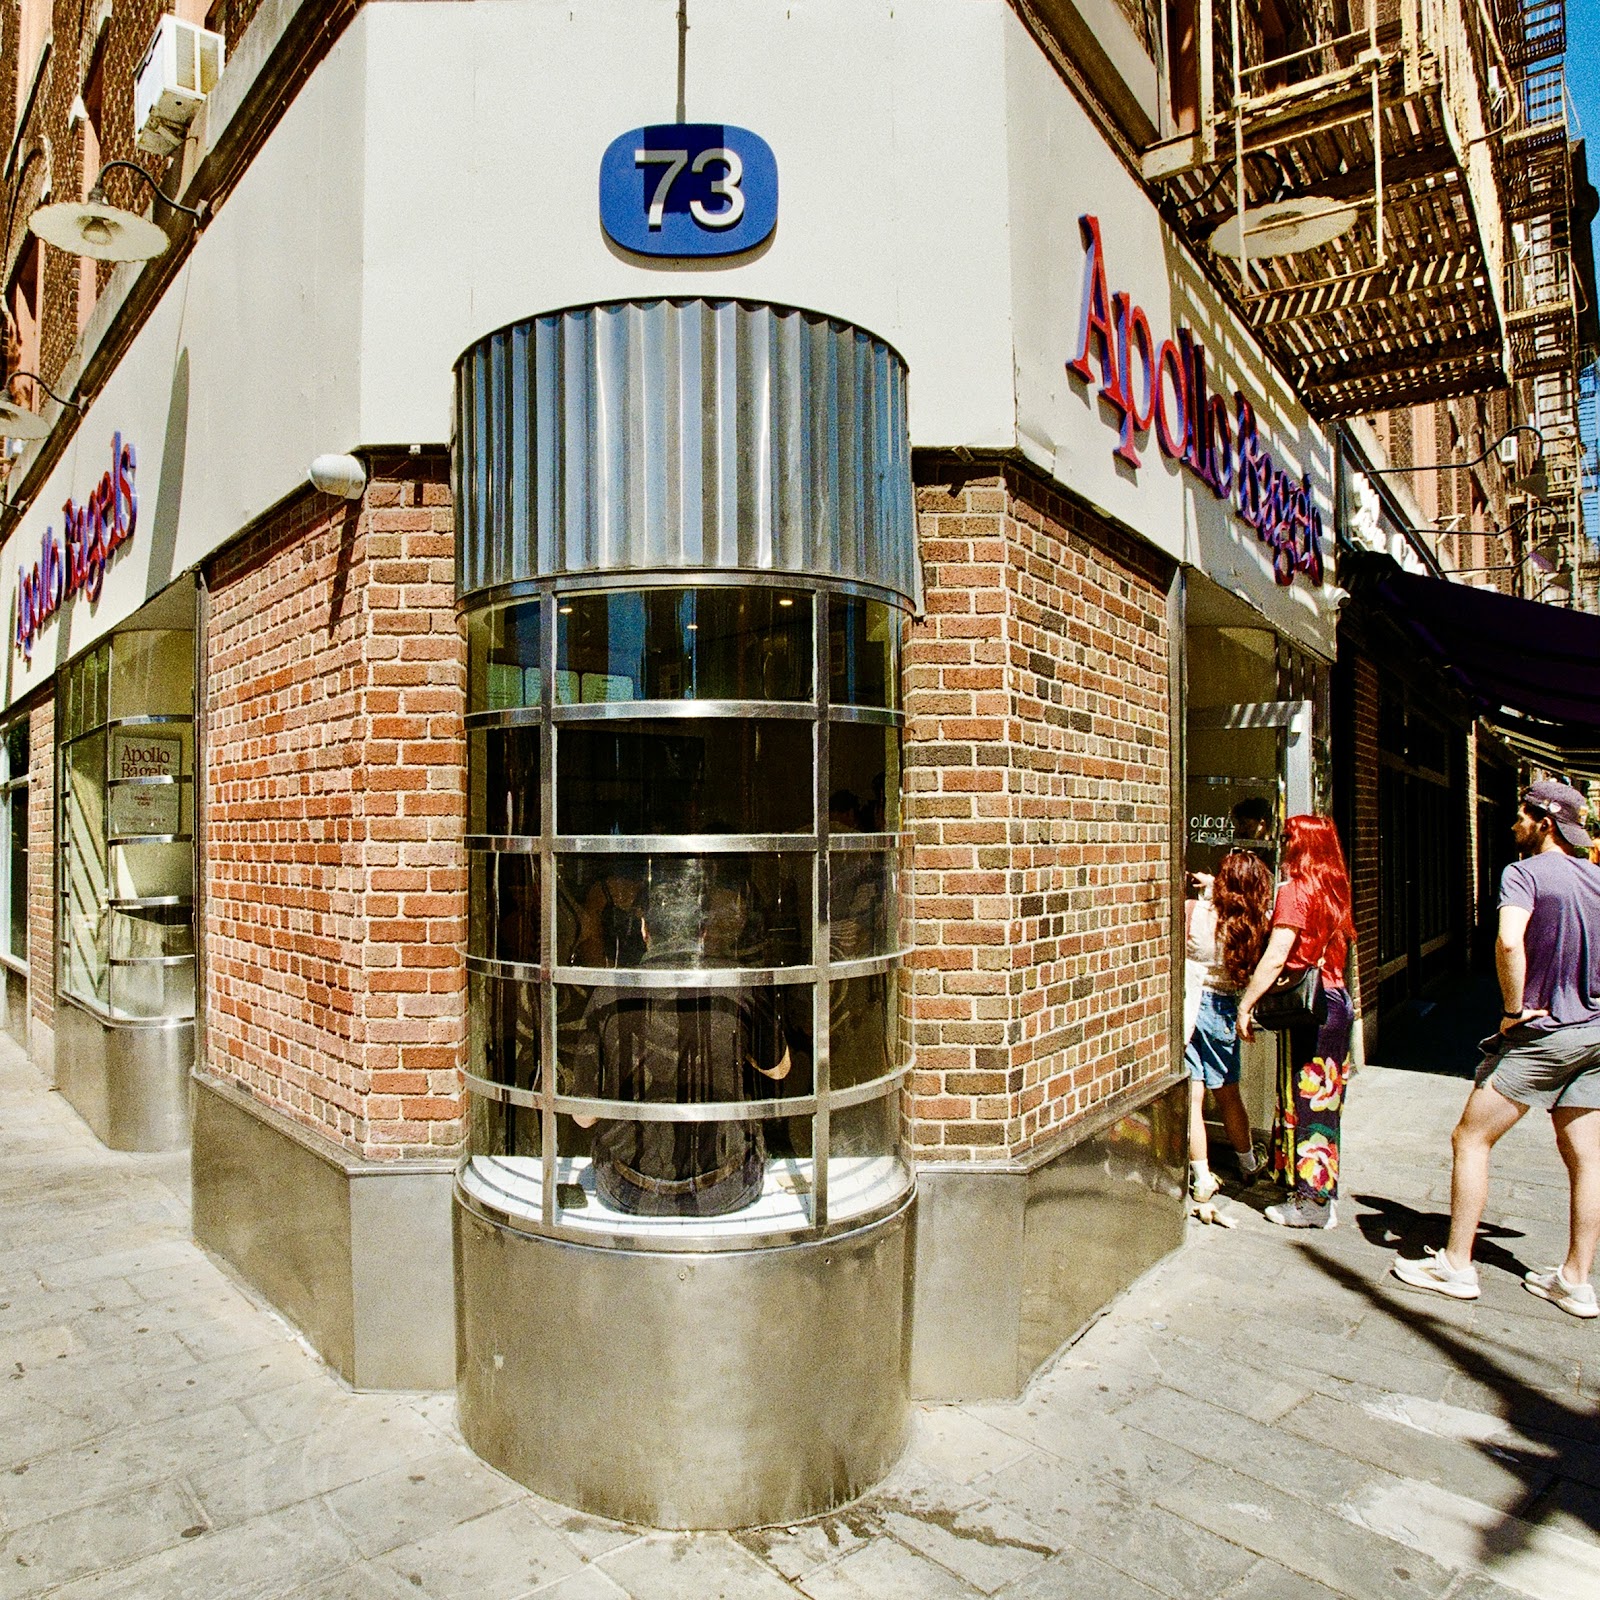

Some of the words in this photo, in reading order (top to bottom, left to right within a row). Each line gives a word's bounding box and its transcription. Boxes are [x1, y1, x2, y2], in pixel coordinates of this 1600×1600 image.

[634, 149, 745, 227] 73
[1065, 213, 1233, 499] Apollo
[1234, 390, 1324, 587] Bagels
[62, 430, 138, 602] Bagels
[121, 744, 170, 765] Apollo
[121, 762, 170, 778] Bagels
